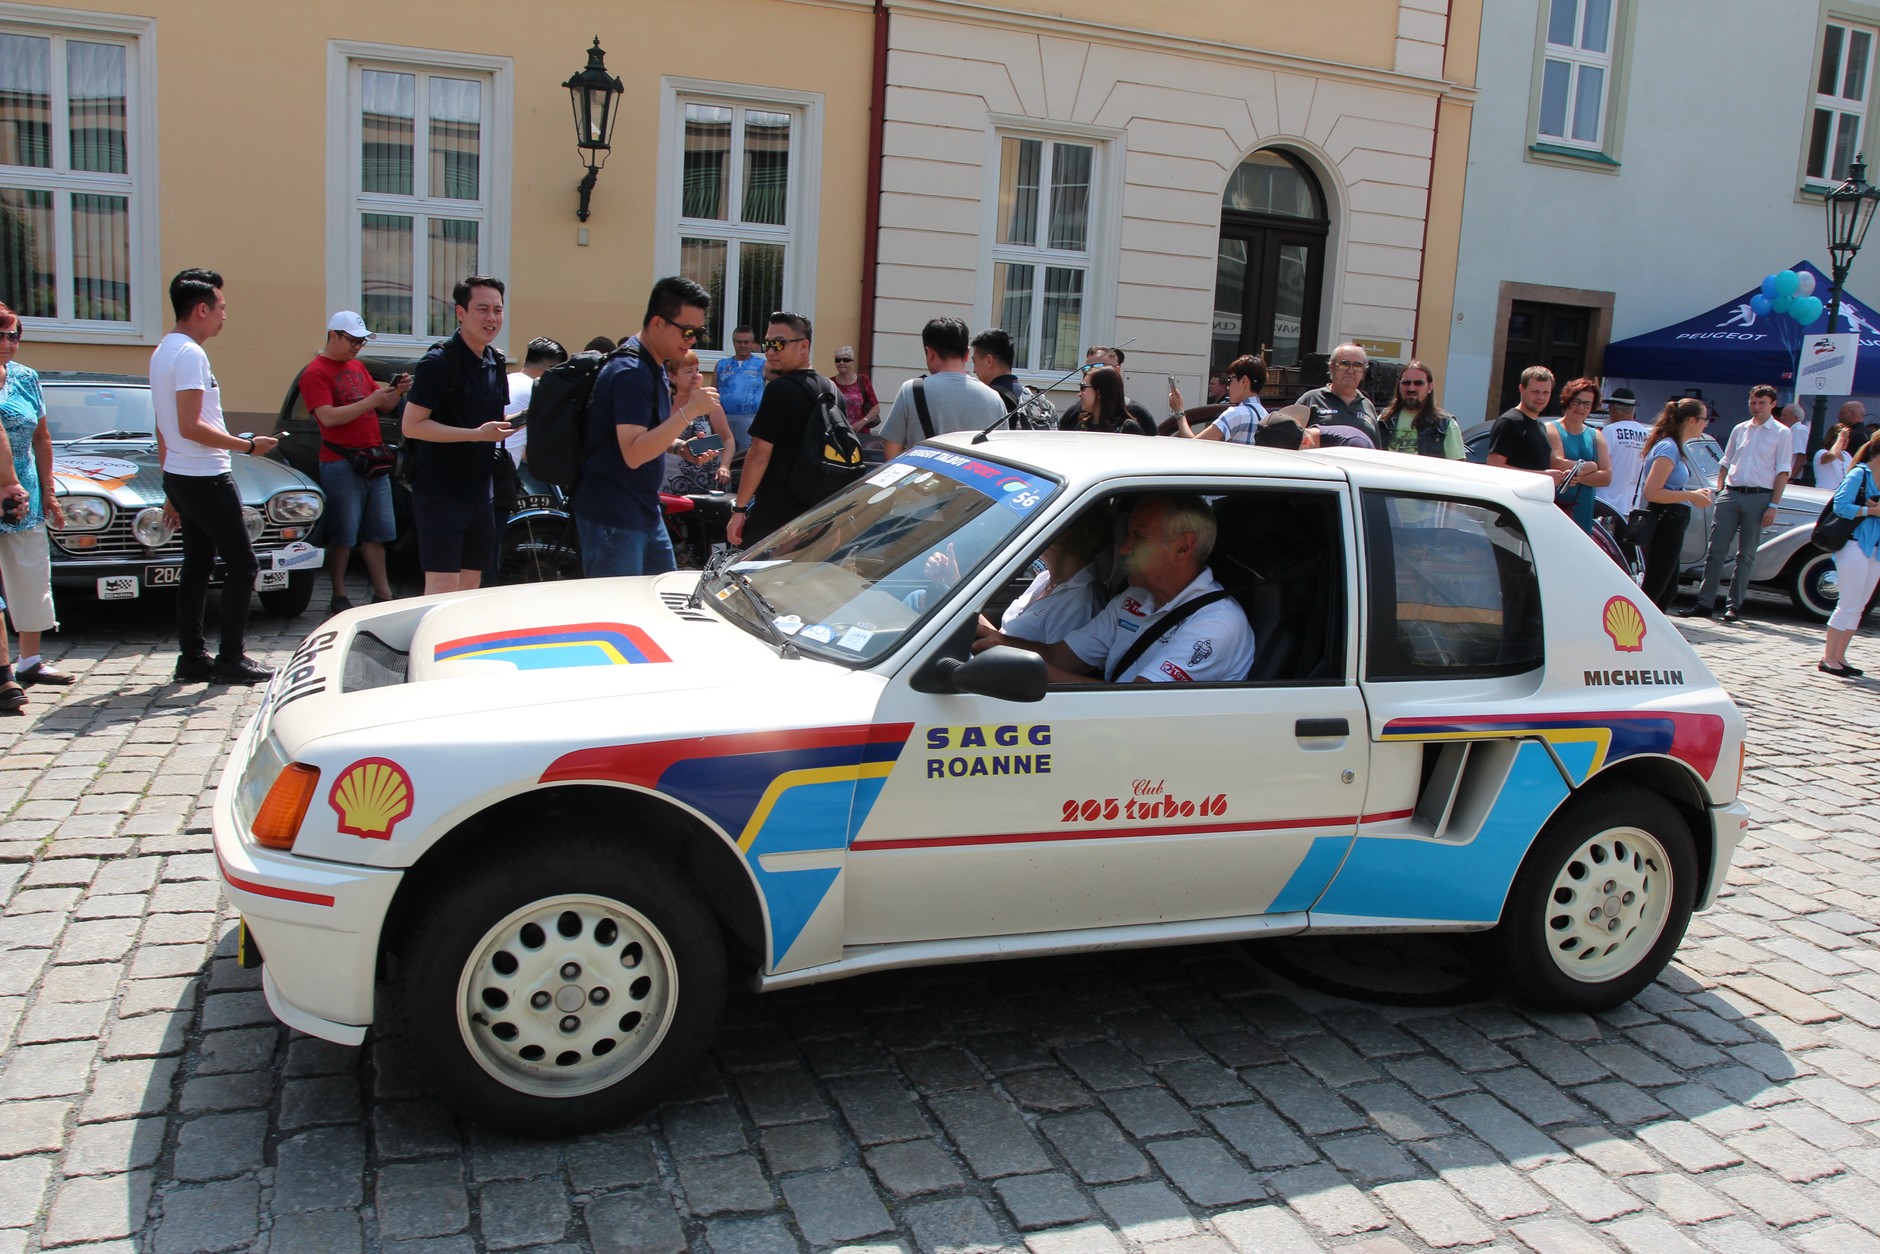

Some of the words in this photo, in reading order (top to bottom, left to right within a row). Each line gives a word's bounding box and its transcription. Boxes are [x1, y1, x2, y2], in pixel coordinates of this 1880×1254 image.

[1676, 331, 1768, 341] PEUGEOT
[933, 452, 972, 467] TALBOT
[962, 461, 1002, 478] SPORT
[517, 496, 550, 509] 929
[1012, 491, 1040, 507] 56
[274, 630, 338, 715] Shell
[1583, 670, 1684, 686] MICHELIN
[927, 725, 1051, 749] SAGG
[927, 754, 1051, 778] ROANNE
[1132, 779, 1165, 796] Club
[1061, 798, 1119, 822] 205
[1124, 794, 1195, 820] turbo
[1199, 793, 1227, 816] 16
